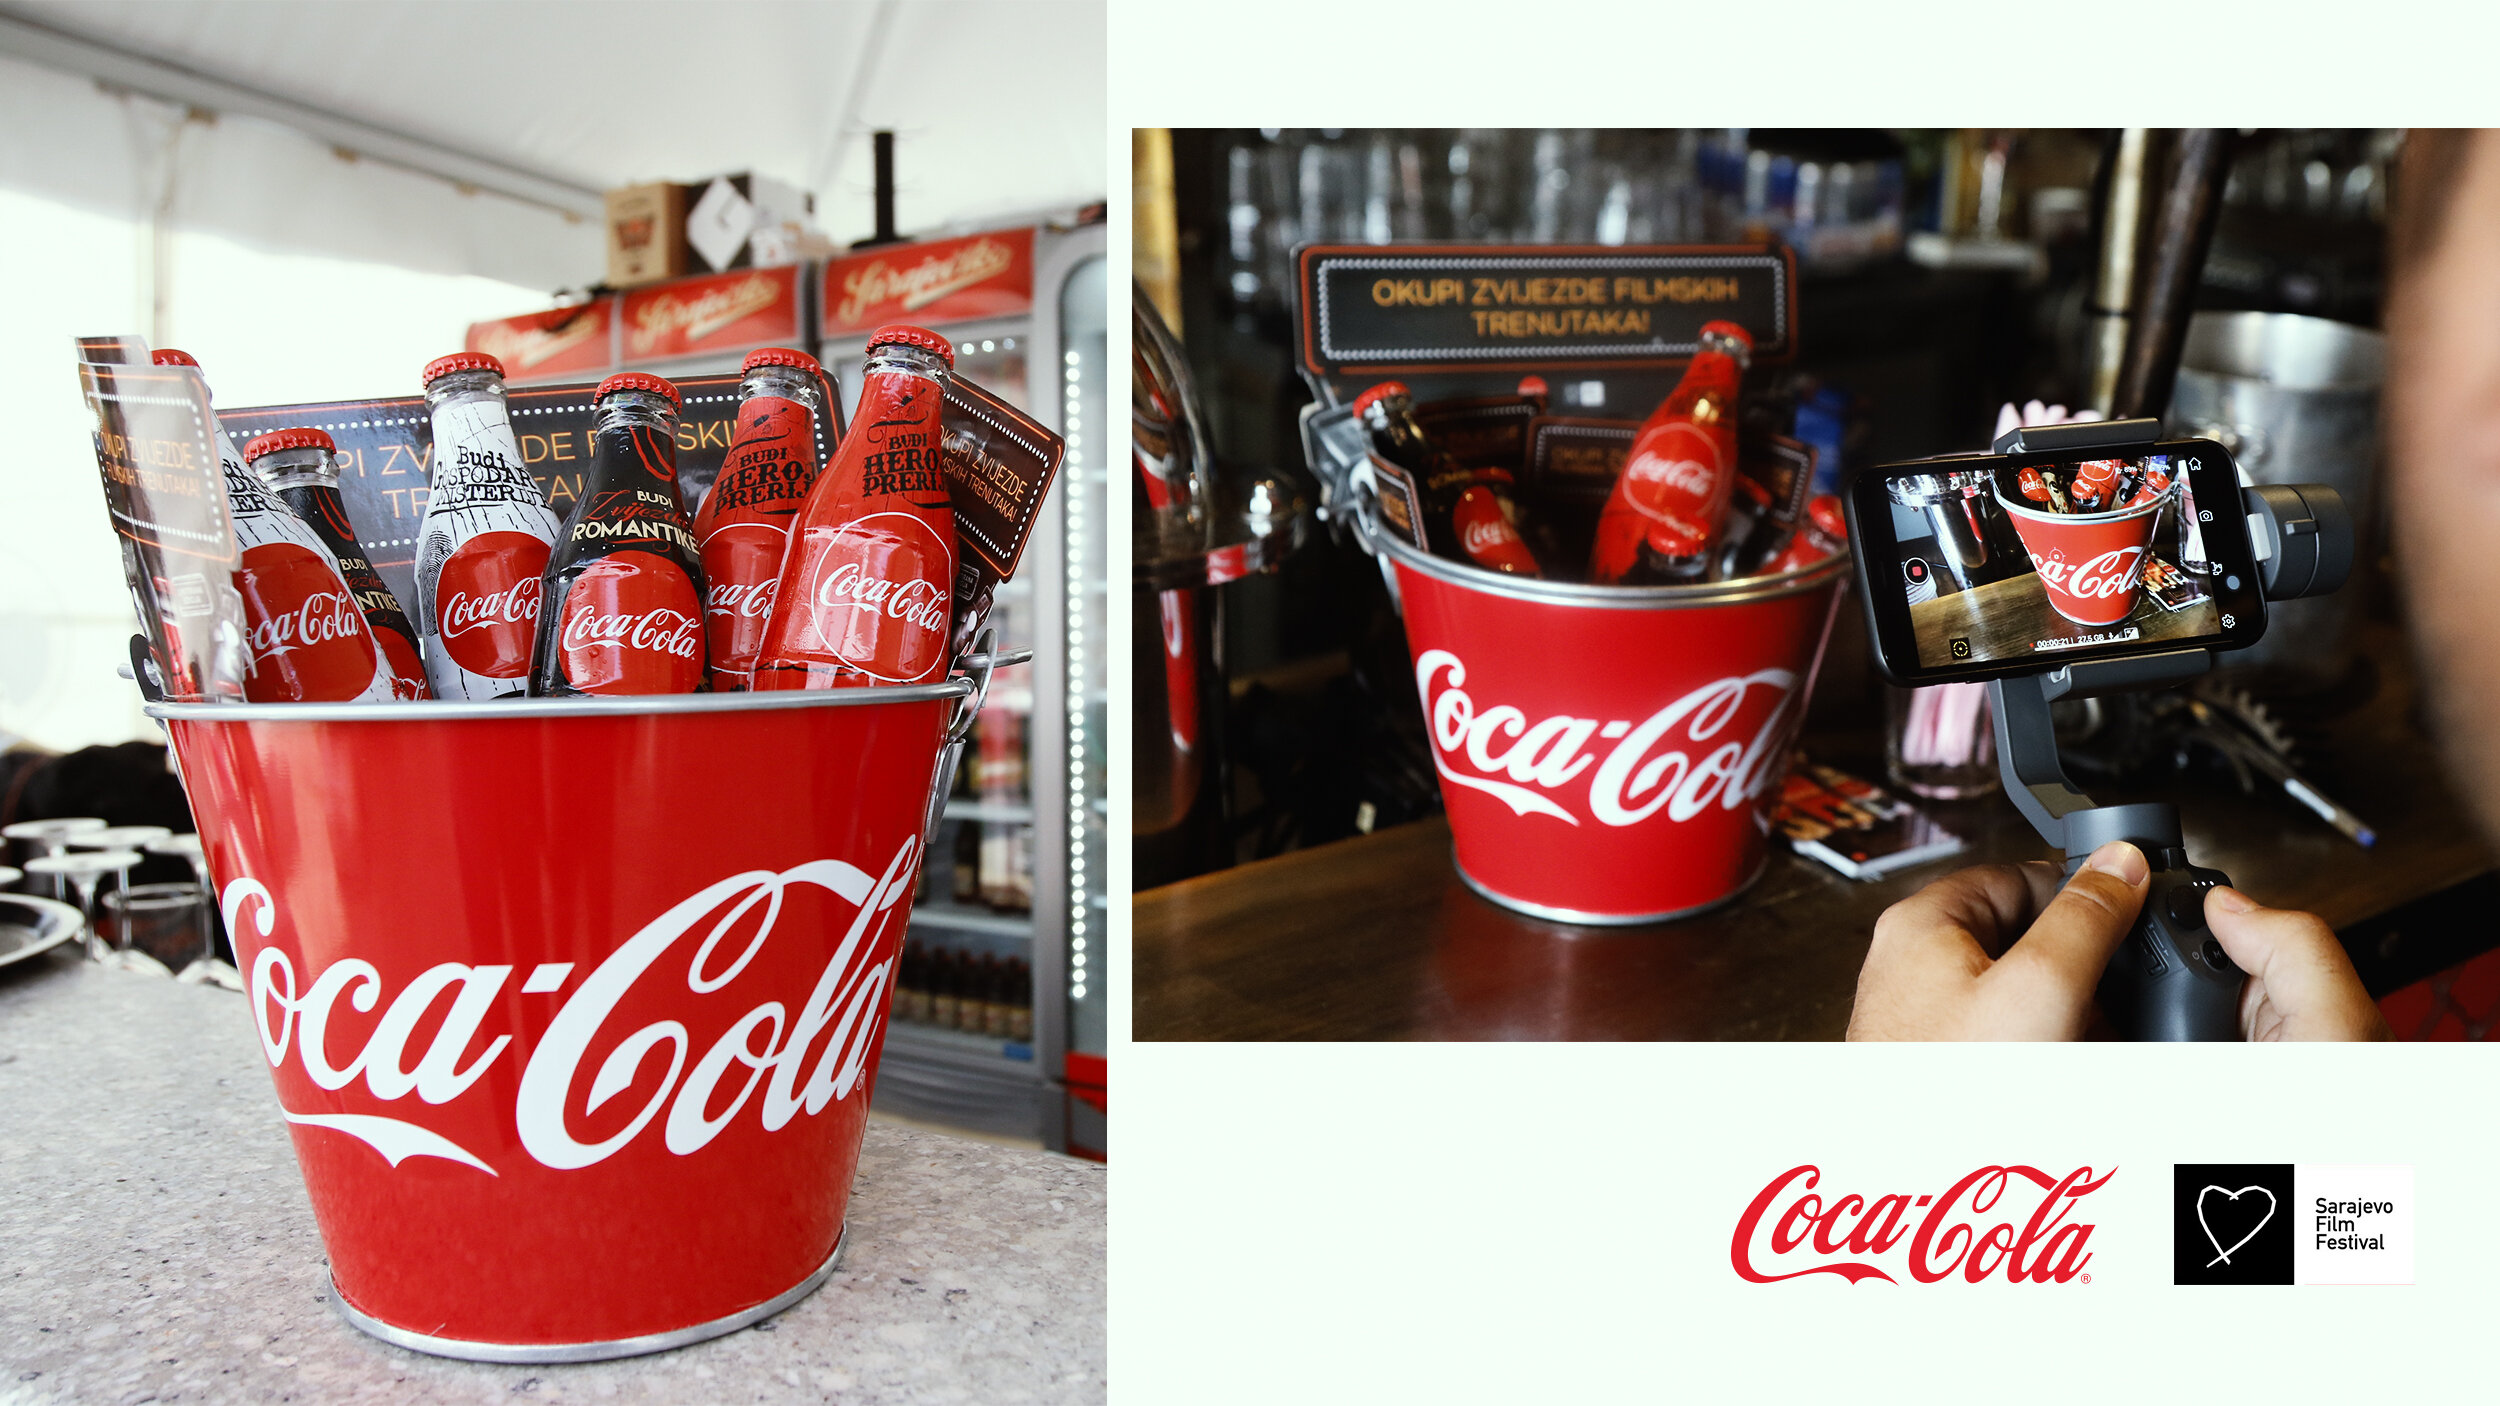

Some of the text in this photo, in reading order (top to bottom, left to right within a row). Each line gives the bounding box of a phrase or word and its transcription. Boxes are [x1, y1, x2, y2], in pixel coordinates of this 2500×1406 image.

[1372, 276, 1740, 307] OKUPI ZVIJEZDE FILMSKIH
[1472, 310, 1652, 339] TRENUTAKA!
[127, 437, 196, 471] ZVIJEZDE
[457, 446, 506, 469] Budi
[740, 448, 788, 469] BUDI
[889, 433, 928, 451] BUDI
[718, 460, 816, 497] HEROJ
[972, 449, 1028, 503] ZVIJEZDE
[636, 490, 674, 509] BUDI
[713, 479, 814, 518] PRERIJ
[967, 473, 1018, 523] TRENUTAKA!
[571, 519, 701, 556] ROMANTIKE
[339, 558, 369, 571] BUDI
[354, 591, 402, 613] NTIKE
[443, 577, 542, 638] Coca-Co
[820, 563, 949, 632] Coca-Cola
[563, 605, 701, 660] Coca-Cola
[2037, 638, 2069, 648] 00:00:21
[2077, 634, 2093, 644] 27.5
[222, 834, 924, 1177] Coca-Cola
